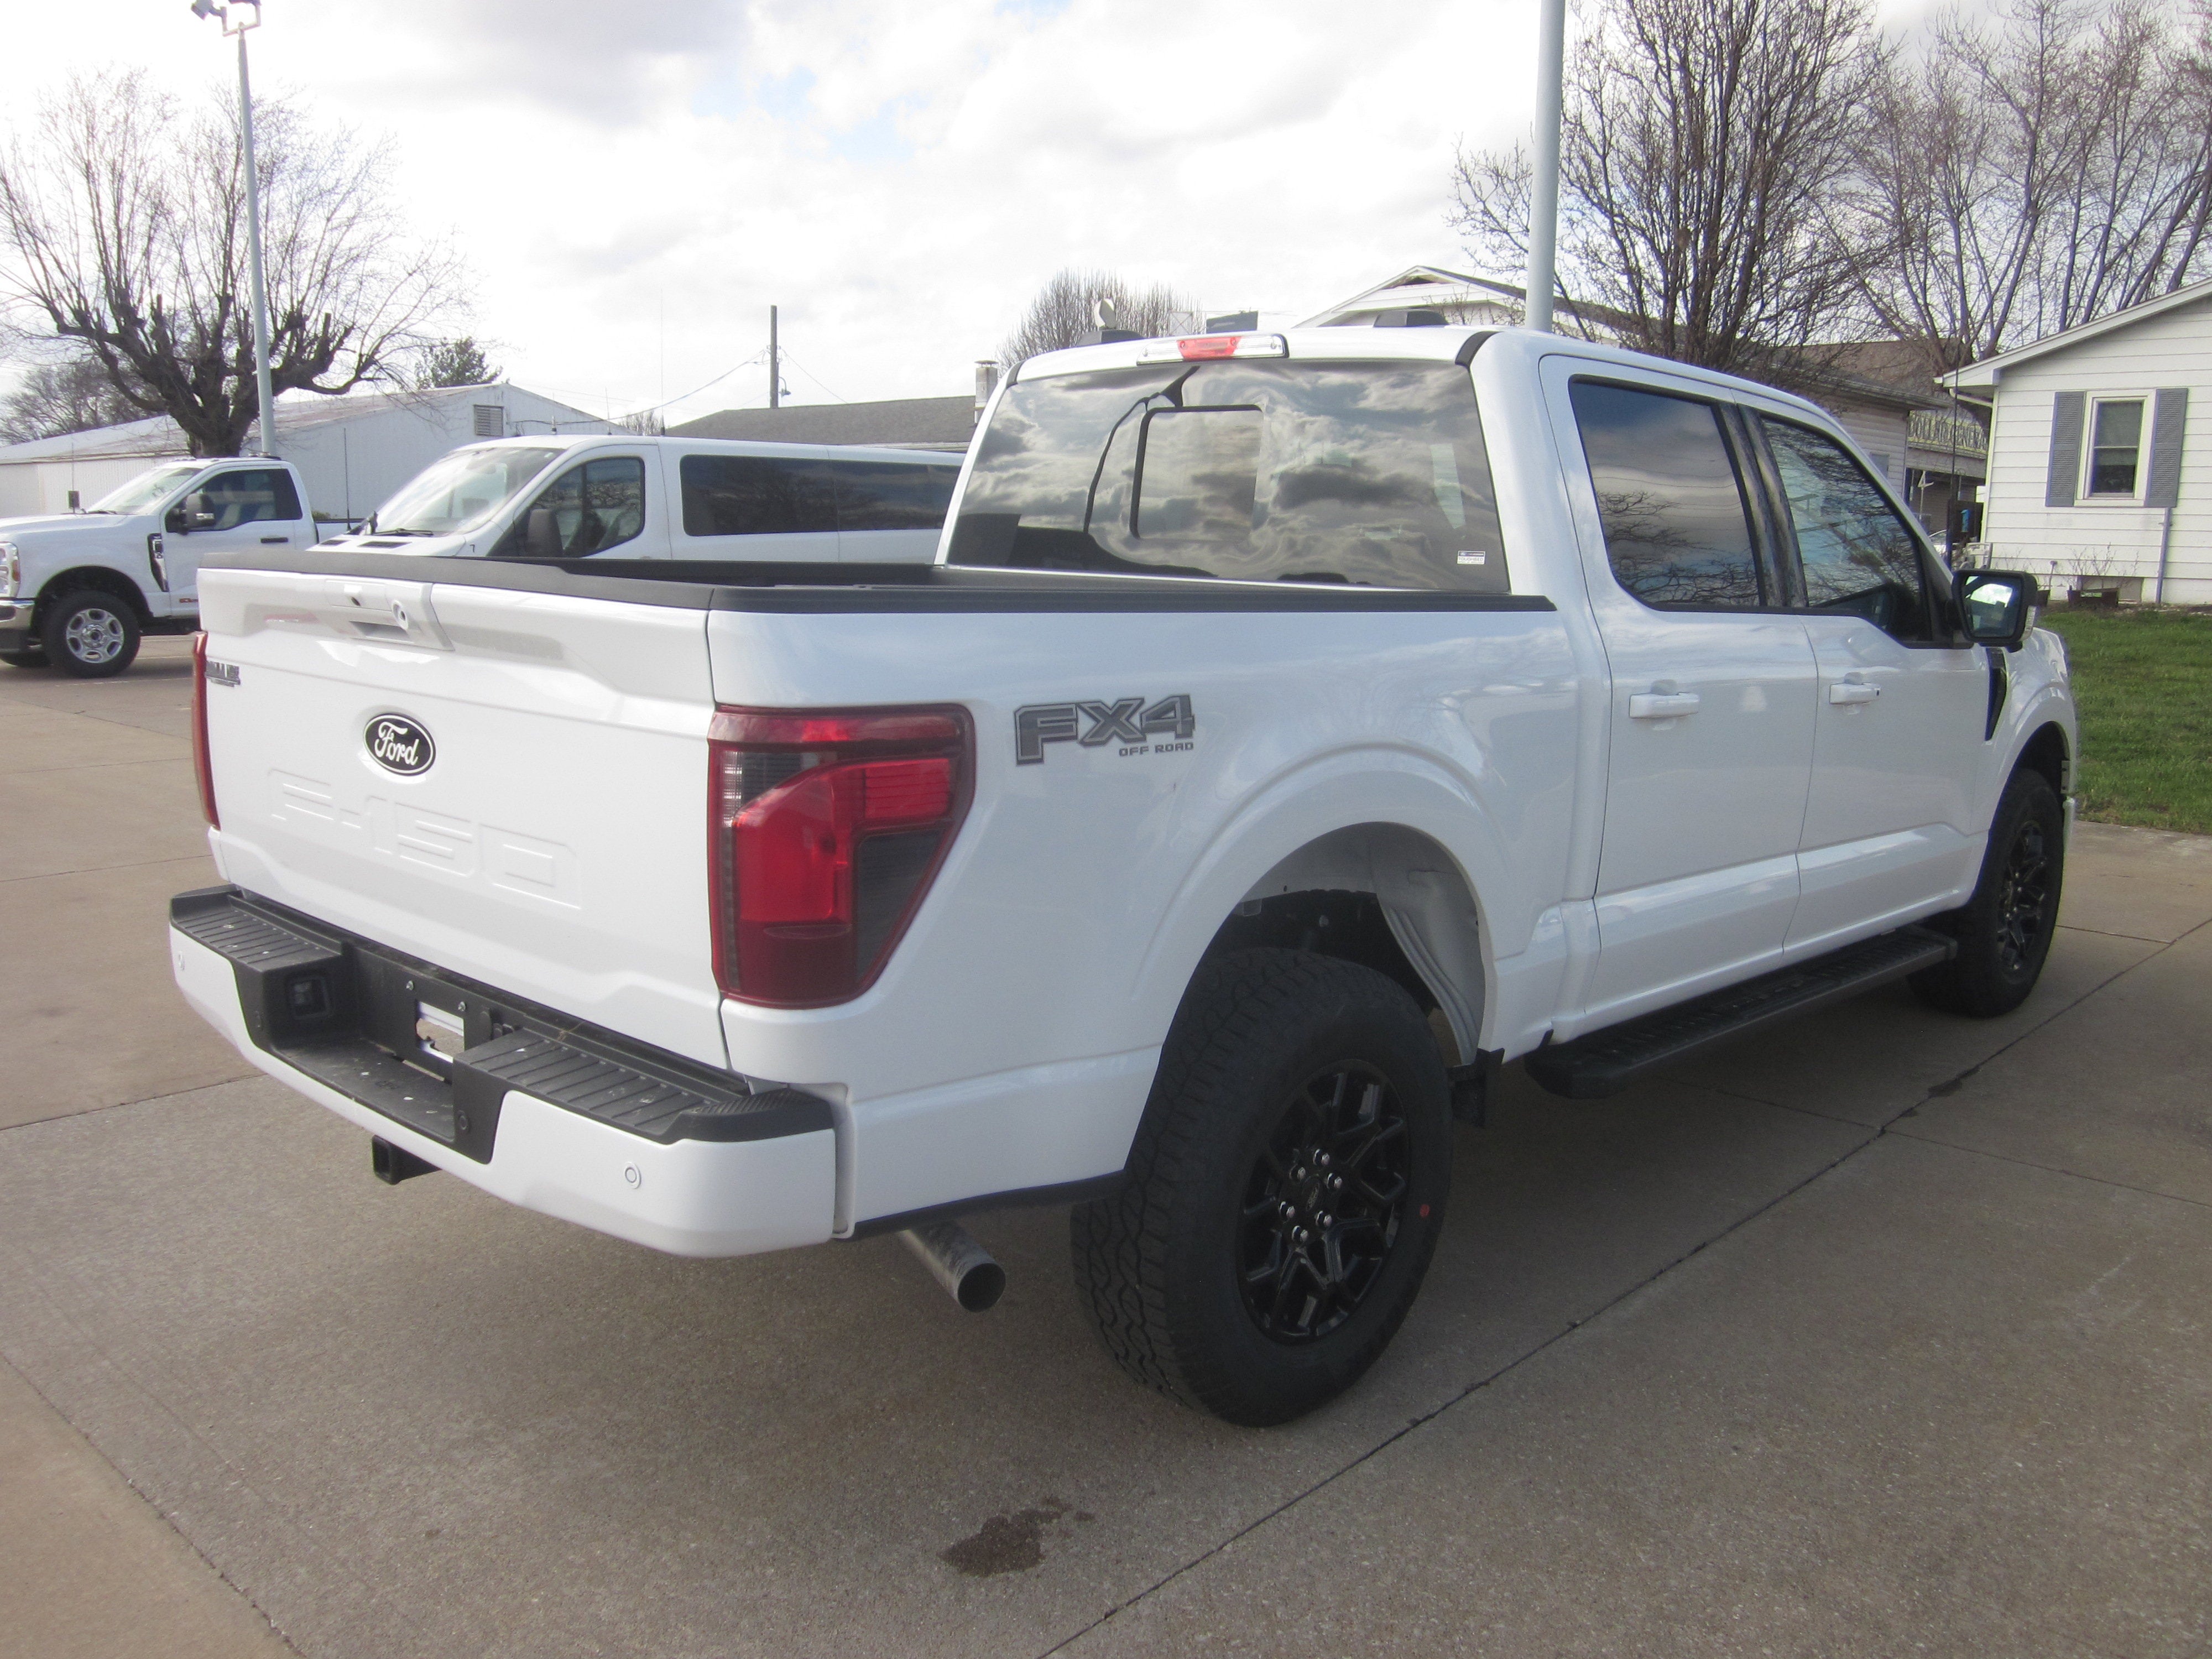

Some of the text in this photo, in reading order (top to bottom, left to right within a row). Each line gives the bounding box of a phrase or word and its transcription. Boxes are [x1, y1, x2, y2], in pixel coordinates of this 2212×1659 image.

[1950, 424, 1987, 450] GENERA
[374, 721, 420, 766] Ford
[1014, 694, 1195, 766] FX4
[1119, 742, 1193, 757] OFF ROAD
[269, 768, 581, 910] F-150
